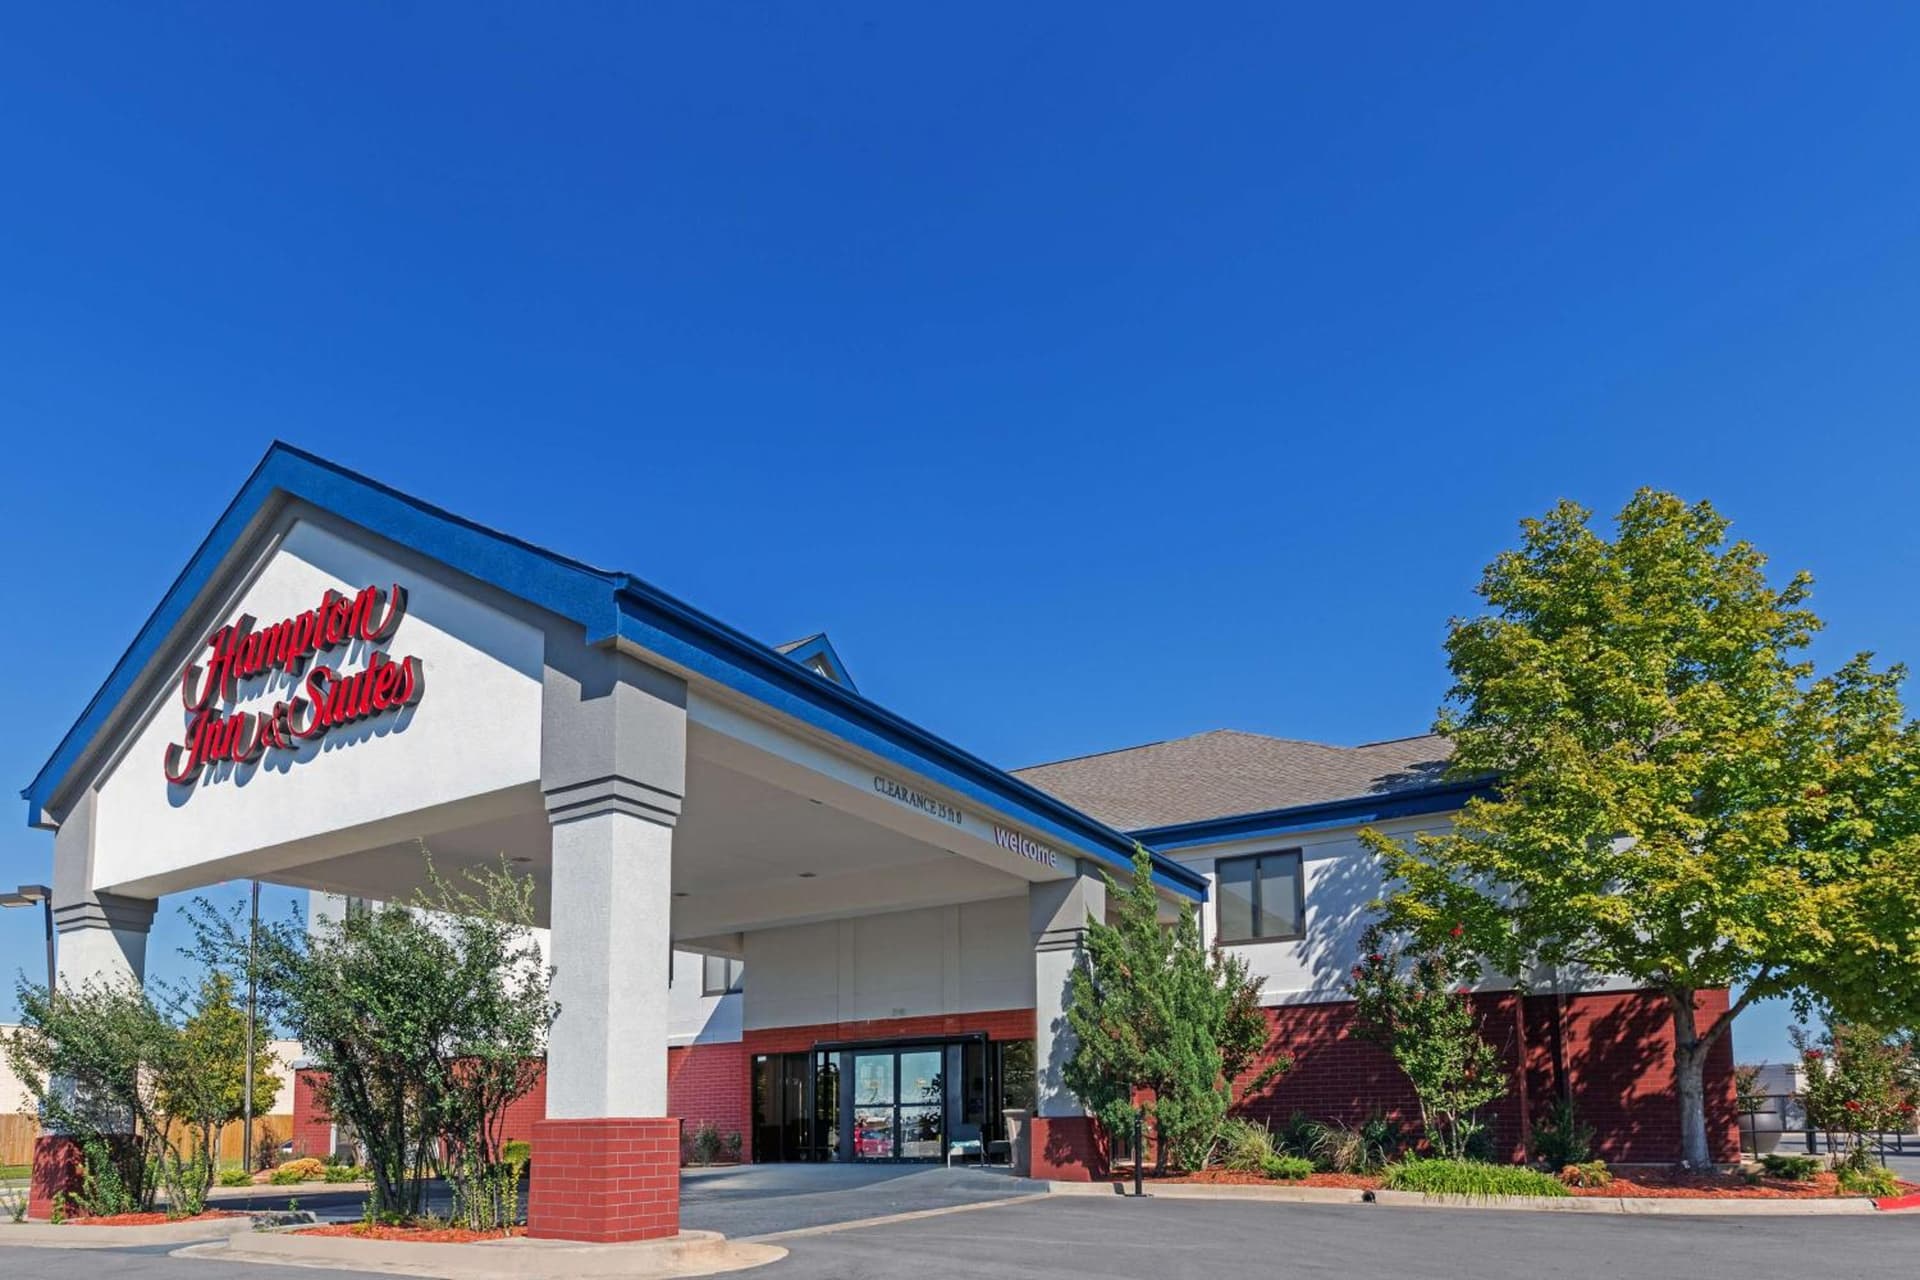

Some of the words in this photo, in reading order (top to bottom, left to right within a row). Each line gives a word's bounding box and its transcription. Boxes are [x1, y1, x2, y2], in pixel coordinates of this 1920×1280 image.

[183, 584, 408, 712] Hampton
[165, 707, 269, 785] Inn
[288, 651, 424, 739] Suites
[874, 776, 936, 815] CLEARANCE
[994, 826, 1057, 867] welcome
